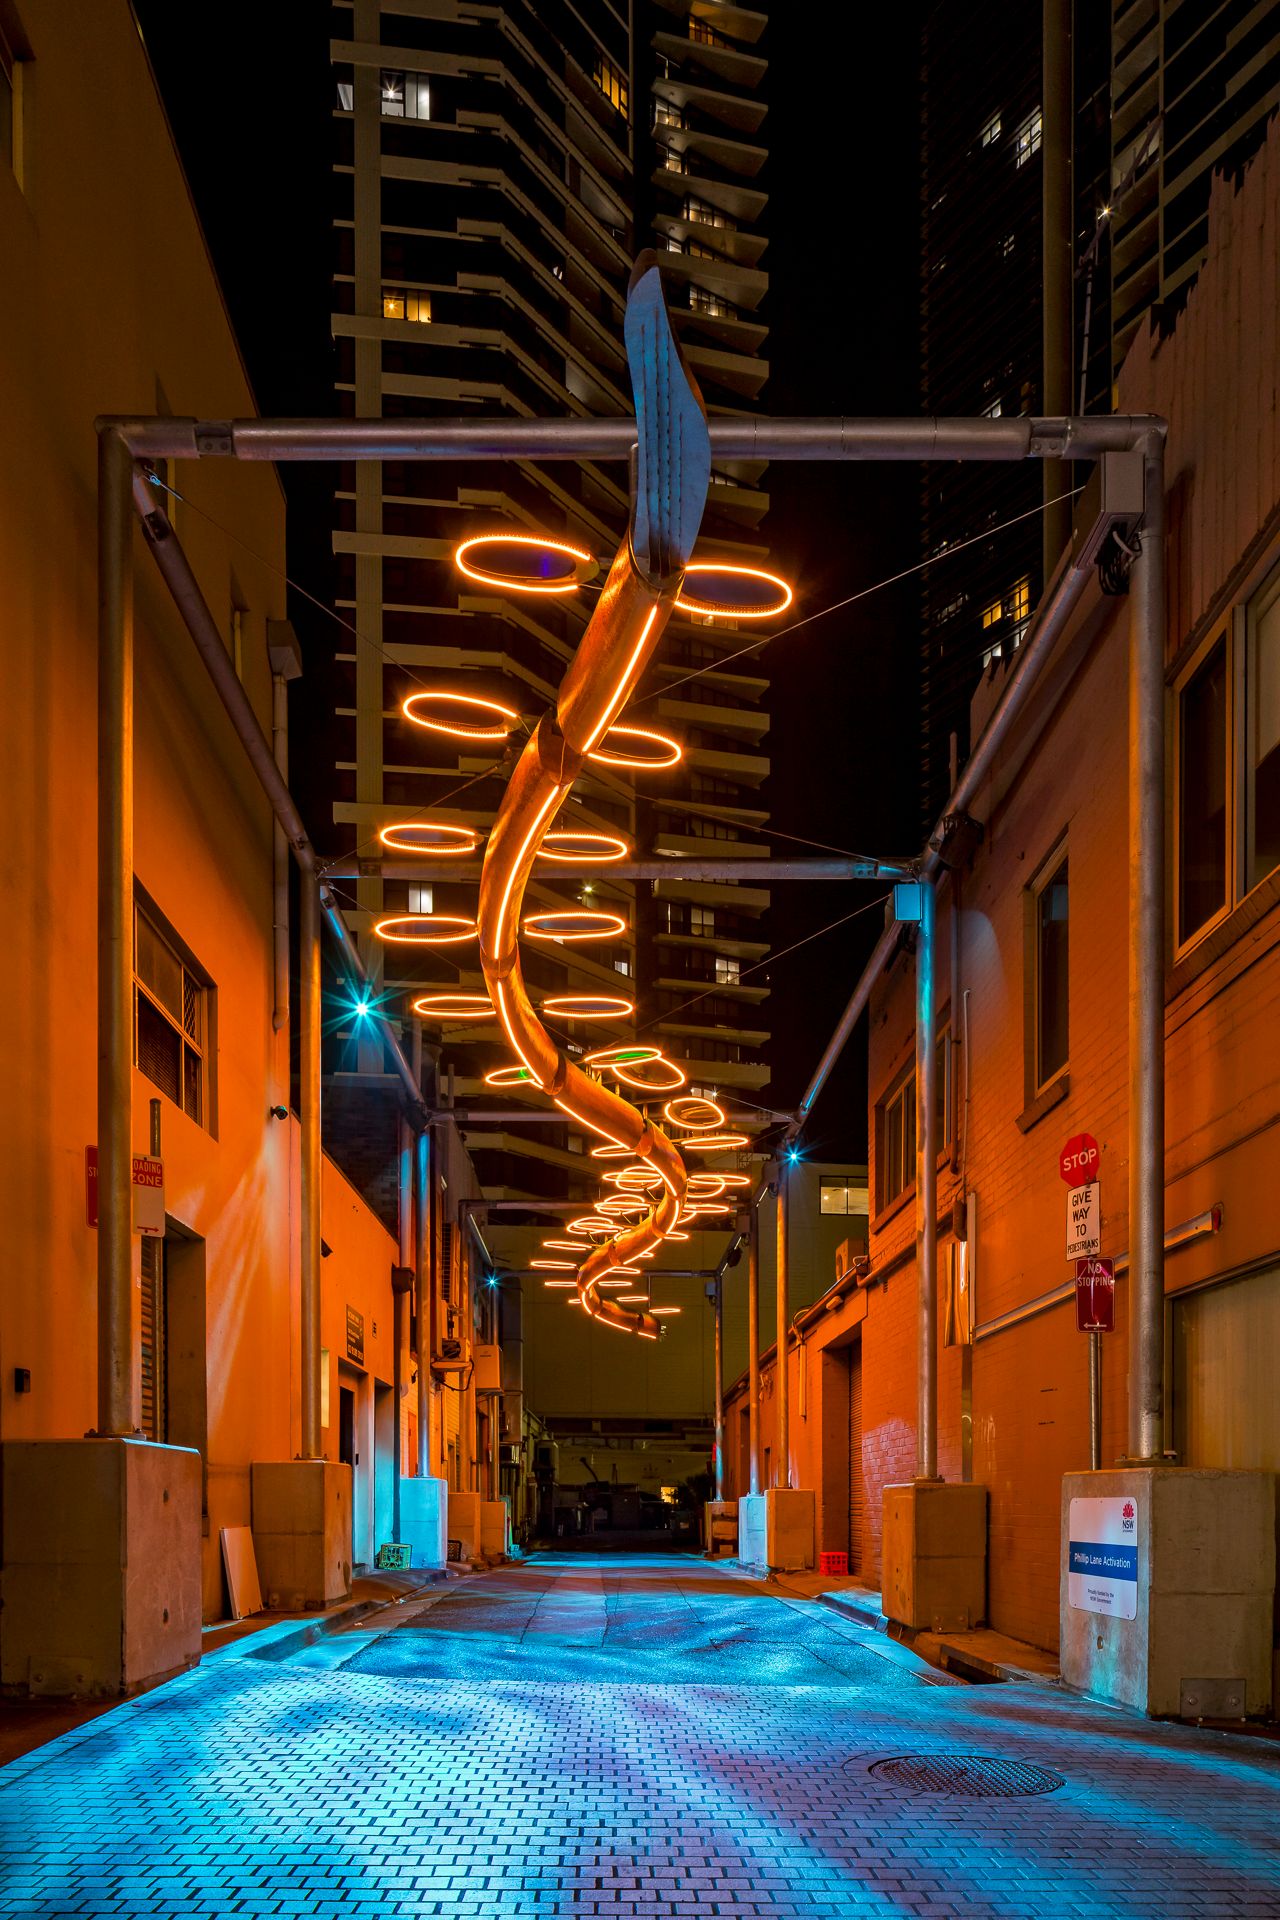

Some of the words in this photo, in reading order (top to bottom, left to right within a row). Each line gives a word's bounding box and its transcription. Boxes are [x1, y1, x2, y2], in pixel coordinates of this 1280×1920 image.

[1063, 1148, 1097, 1171] STOP
[134, 1160, 160, 1174] OADING
[1072, 1191, 1092, 1207] GIVE
[1073, 1207, 1090, 1222] WAY
[1076, 1224, 1087, 1237] TO
[1068, 1238, 1098, 1254] PEDESTRIANS
[1088, 1263, 1102, 1274] NO
[1078, 1276, 1113, 1287] STOPPING
[1122, 1520, 1134, 1529] NSW
[1074, 1553, 1089, 1566] Phillip
[1090, 1555, 1102, 1565] Lane
[1102, 1556, 1130, 1568] Activation
